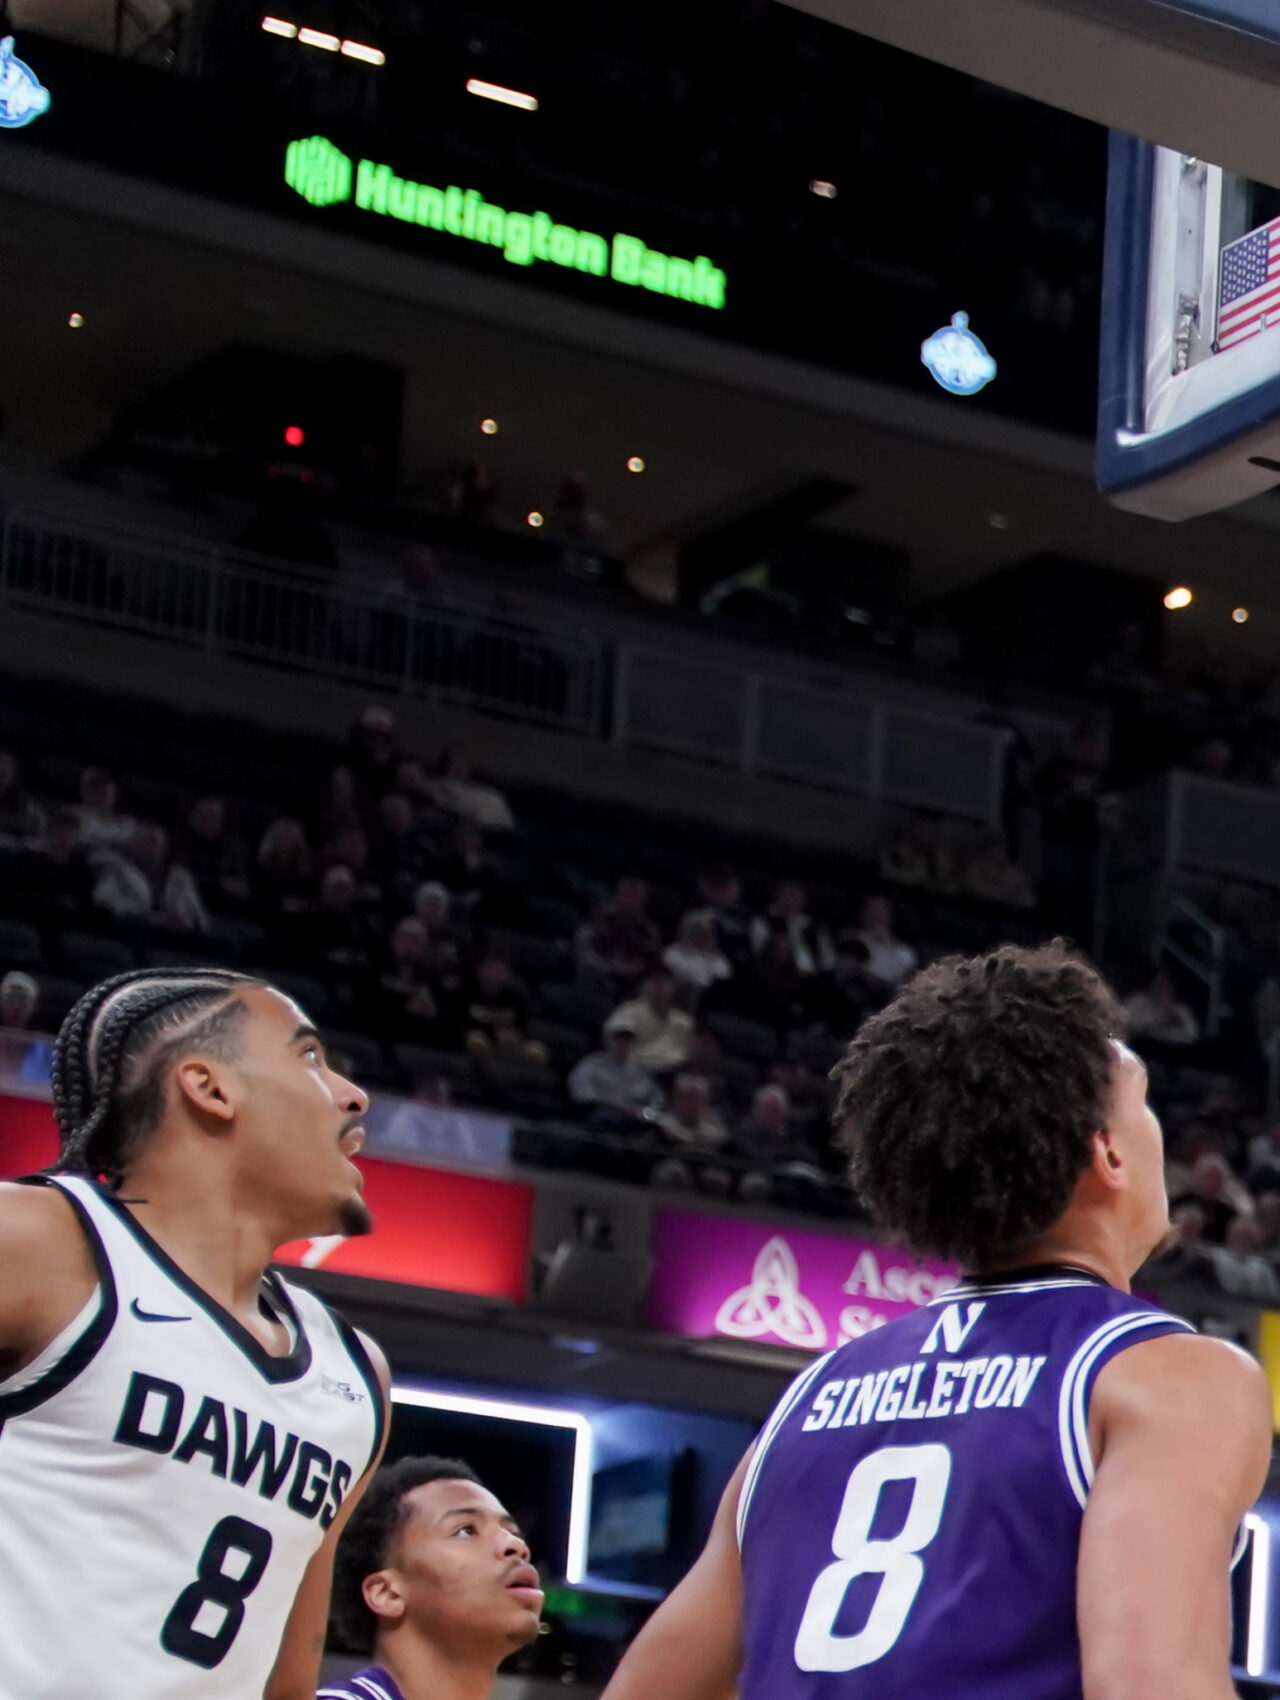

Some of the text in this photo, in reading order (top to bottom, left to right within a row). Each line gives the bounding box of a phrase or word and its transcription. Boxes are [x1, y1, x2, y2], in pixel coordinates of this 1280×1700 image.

[355, 158, 727, 310] Huntington Bank
[801, 1355, 1046, 1432] SINGLETON
[920, 1302, 987, 1353] N
[112, 1370, 353, 1533] DAWGS
[160, 1515, 274, 1669] 8
[794, 1443, 952, 1672] 8
